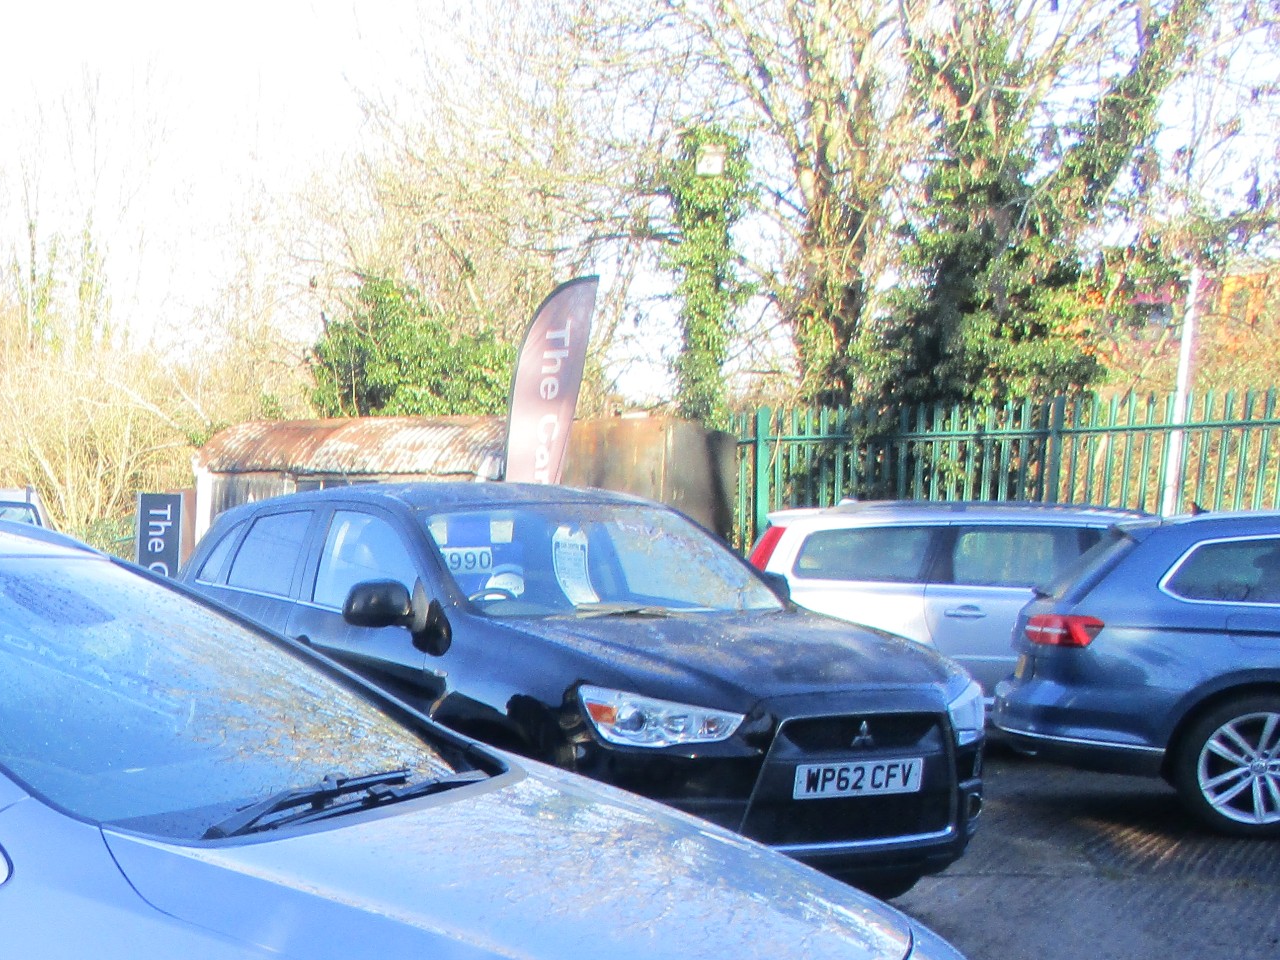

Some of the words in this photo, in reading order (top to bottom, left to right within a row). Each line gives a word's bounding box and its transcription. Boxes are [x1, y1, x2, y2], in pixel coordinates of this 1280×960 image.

[539, 320, 572, 400] The
[148, 504, 172, 553] The
[444, 551, 491, 570] 990
[805, 766, 865, 793] WP62
[870, 763, 913, 788] CFV
